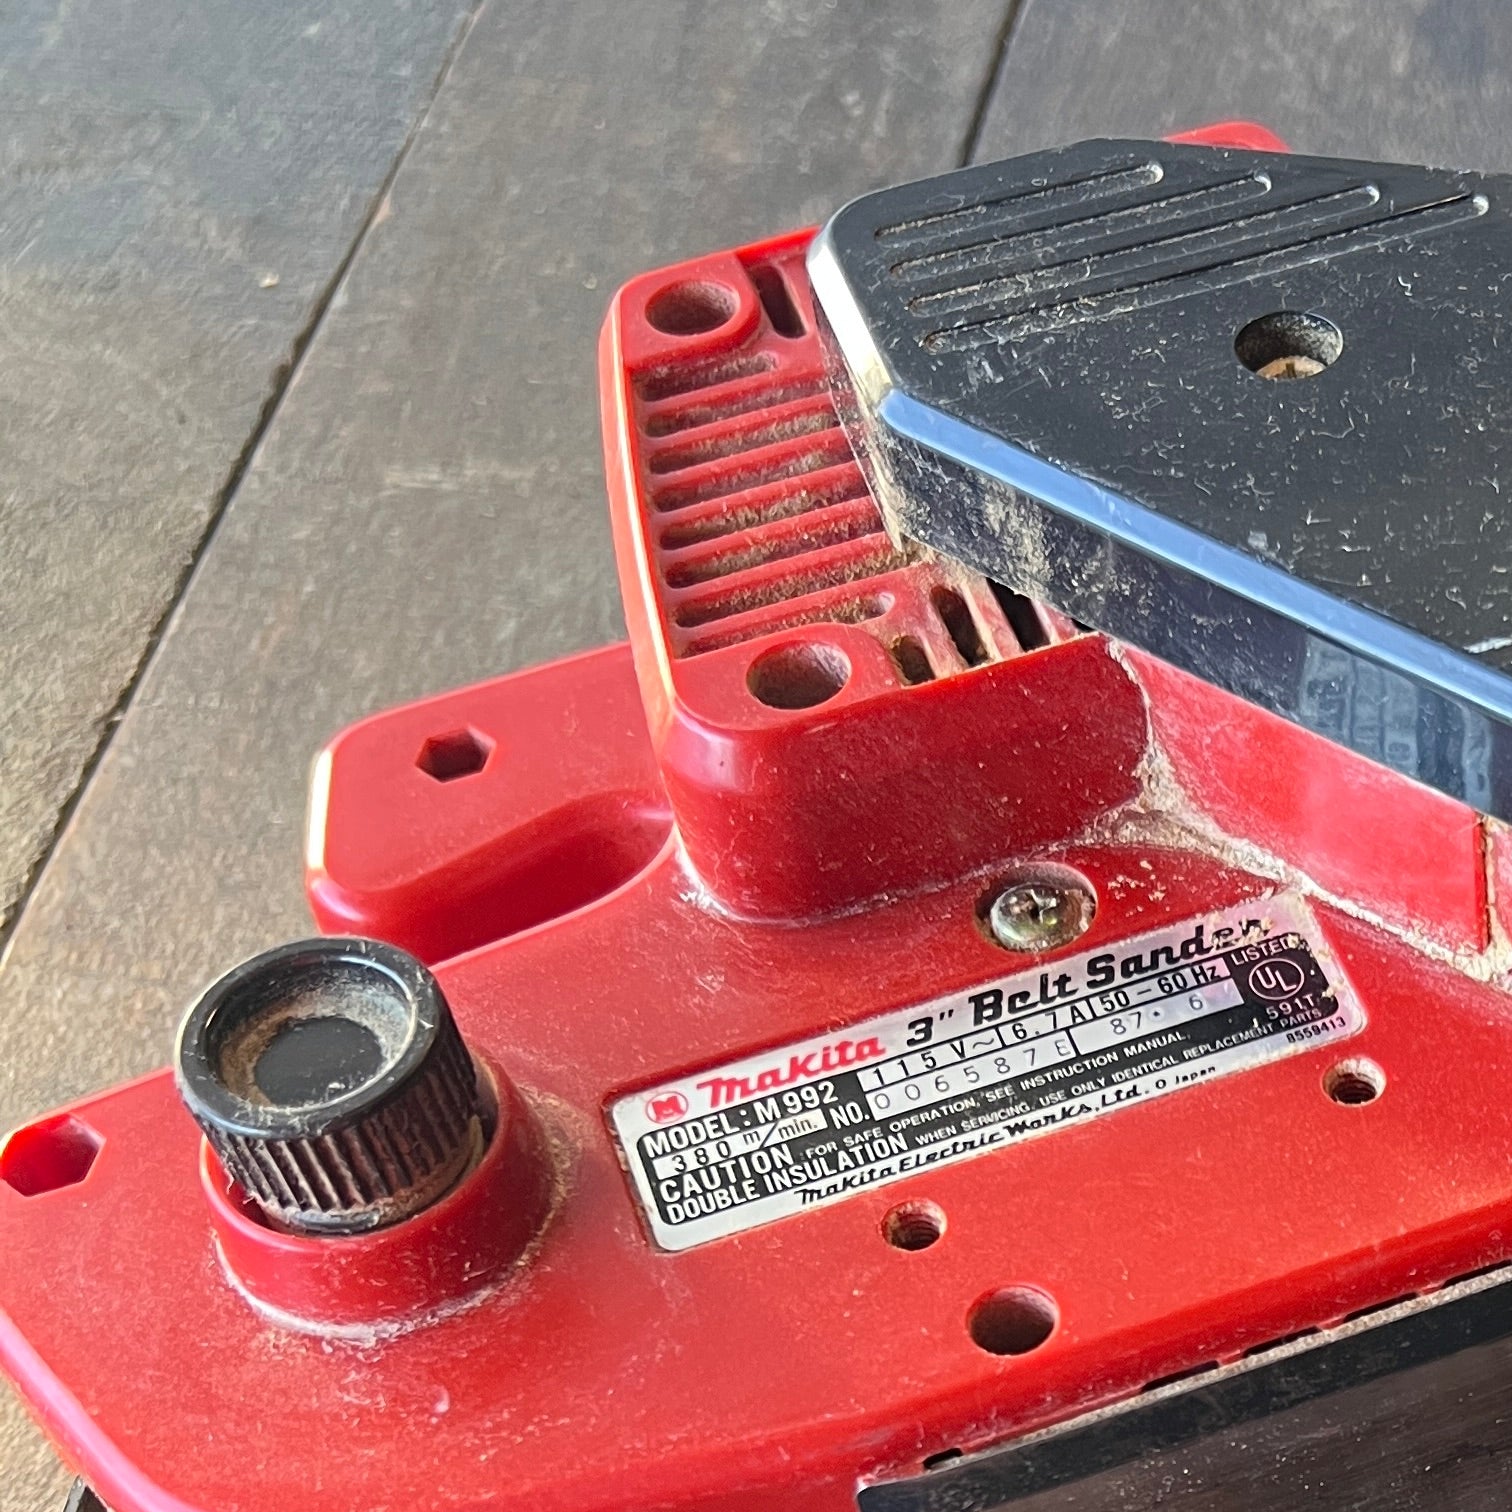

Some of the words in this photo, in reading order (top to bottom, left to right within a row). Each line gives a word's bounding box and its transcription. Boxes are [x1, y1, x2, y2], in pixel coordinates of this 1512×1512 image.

[906, 1009, 954, 1047] 3"
[968, 973, 1079, 1026] Belt
[1086, 919, 1271, 989] Sander
[1255, 966, 1297, 992] UL
[752, 1081, 839, 1124] M992
[830, 1101, 870, 1130] NO.
[843, 1126, 884, 1148] SAFE
[985, 1084, 1015, 1103] SEE
[1020, 1051, 1119, 1091] INSTRUCTION
[899, 1131, 1004, 1173] Electric
[1175, 1064, 1217, 1086] Japan
[915, 1125, 957, 1146] WHEN
[1040, 1091, 1067, 1107] USE
[1071, 1077, 1106, 1097] ONLY
[1112, 1055, 1178, 1084] IDENTICAL
[1183, 1021, 1275, 1061] REPLACEMENT
[1280, 1007, 1322, 1028] PARTS
[666, 1180, 760, 1224] DOUBLE
[763, 1132, 909, 1193] INSULATION
